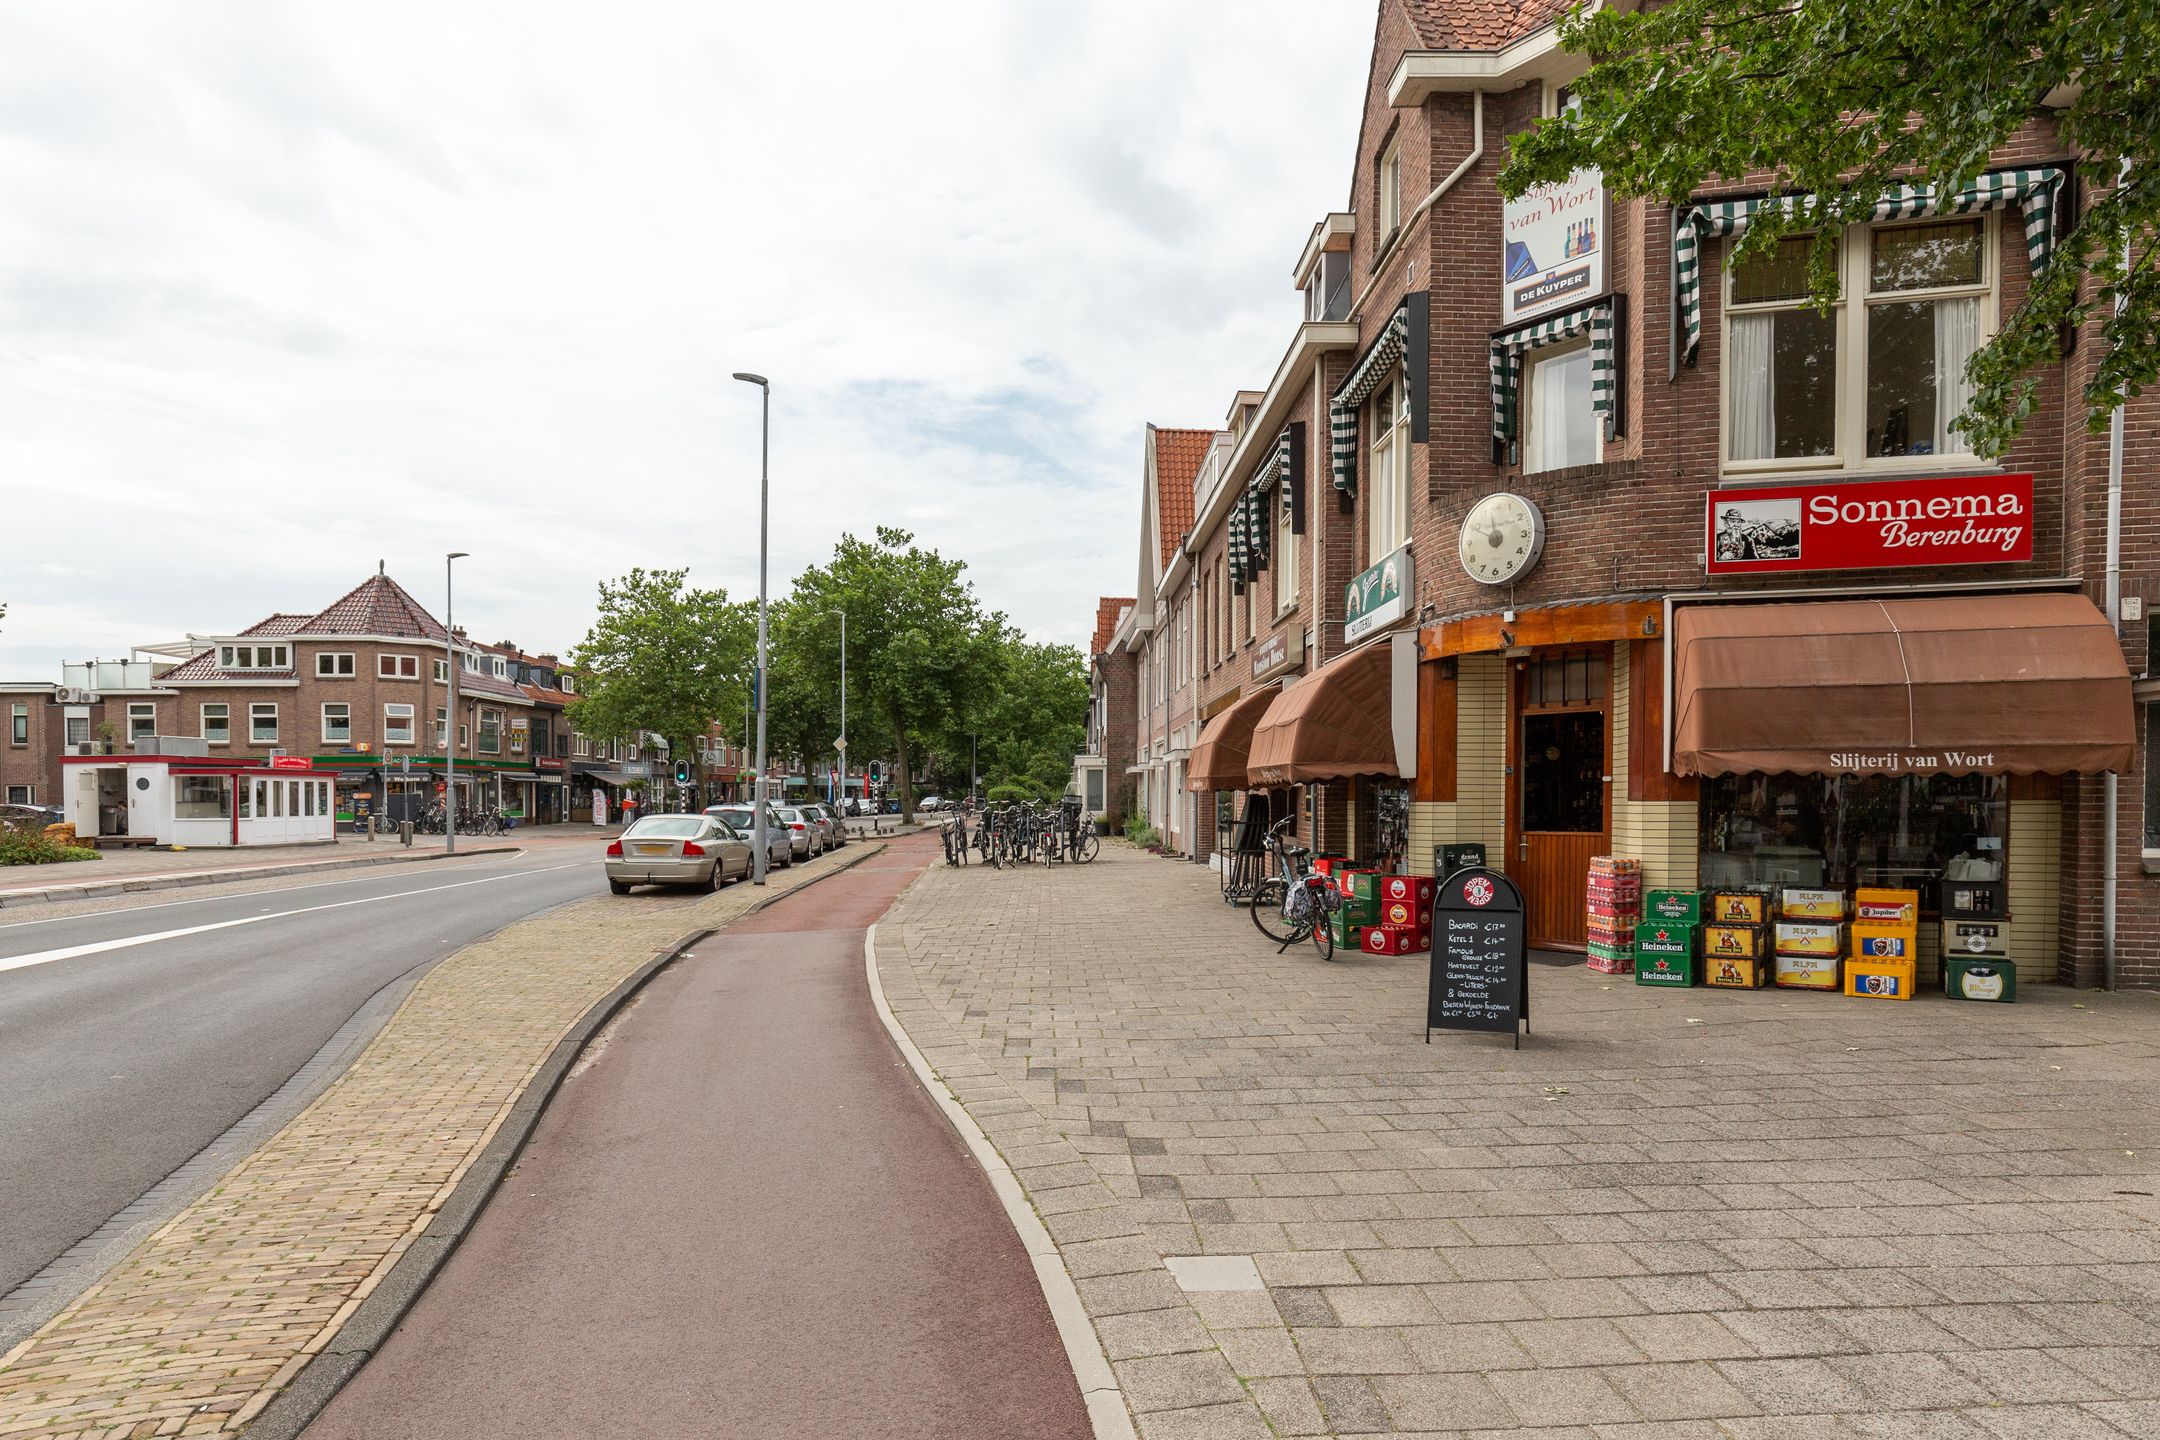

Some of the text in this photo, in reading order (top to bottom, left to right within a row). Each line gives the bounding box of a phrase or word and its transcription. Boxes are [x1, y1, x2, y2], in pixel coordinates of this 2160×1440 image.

[1509, 186, 1596, 231] van Wort
[1520, 290, 1535, 302] DE
[1536, 275, 1583, 297] KUYPER
[1809, 493, 2023, 525] Sonnema
[1516, 513, 1524, 521] 2
[1520, 530, 1528, 538] 3
[1880, 519, 2023, 552] Berenburg
[1516, 547, 1524, 555] 4
[1480, 564, 1486, 573] 7
[1506, 561, 1512, 569] 5
[1830, 752, 1994, 771] Slijterij van Wort
[1464, 877, 1490, 892] JOPEN
[1468, 890, 1493, 906] JOPEN
[1448, 934, 1467, 942] KETEL
[1642, 942, 1683, 952] Heineken
[1642, 972, 1683, 981] Heineken
[1448, 988, 1454, 998] &
